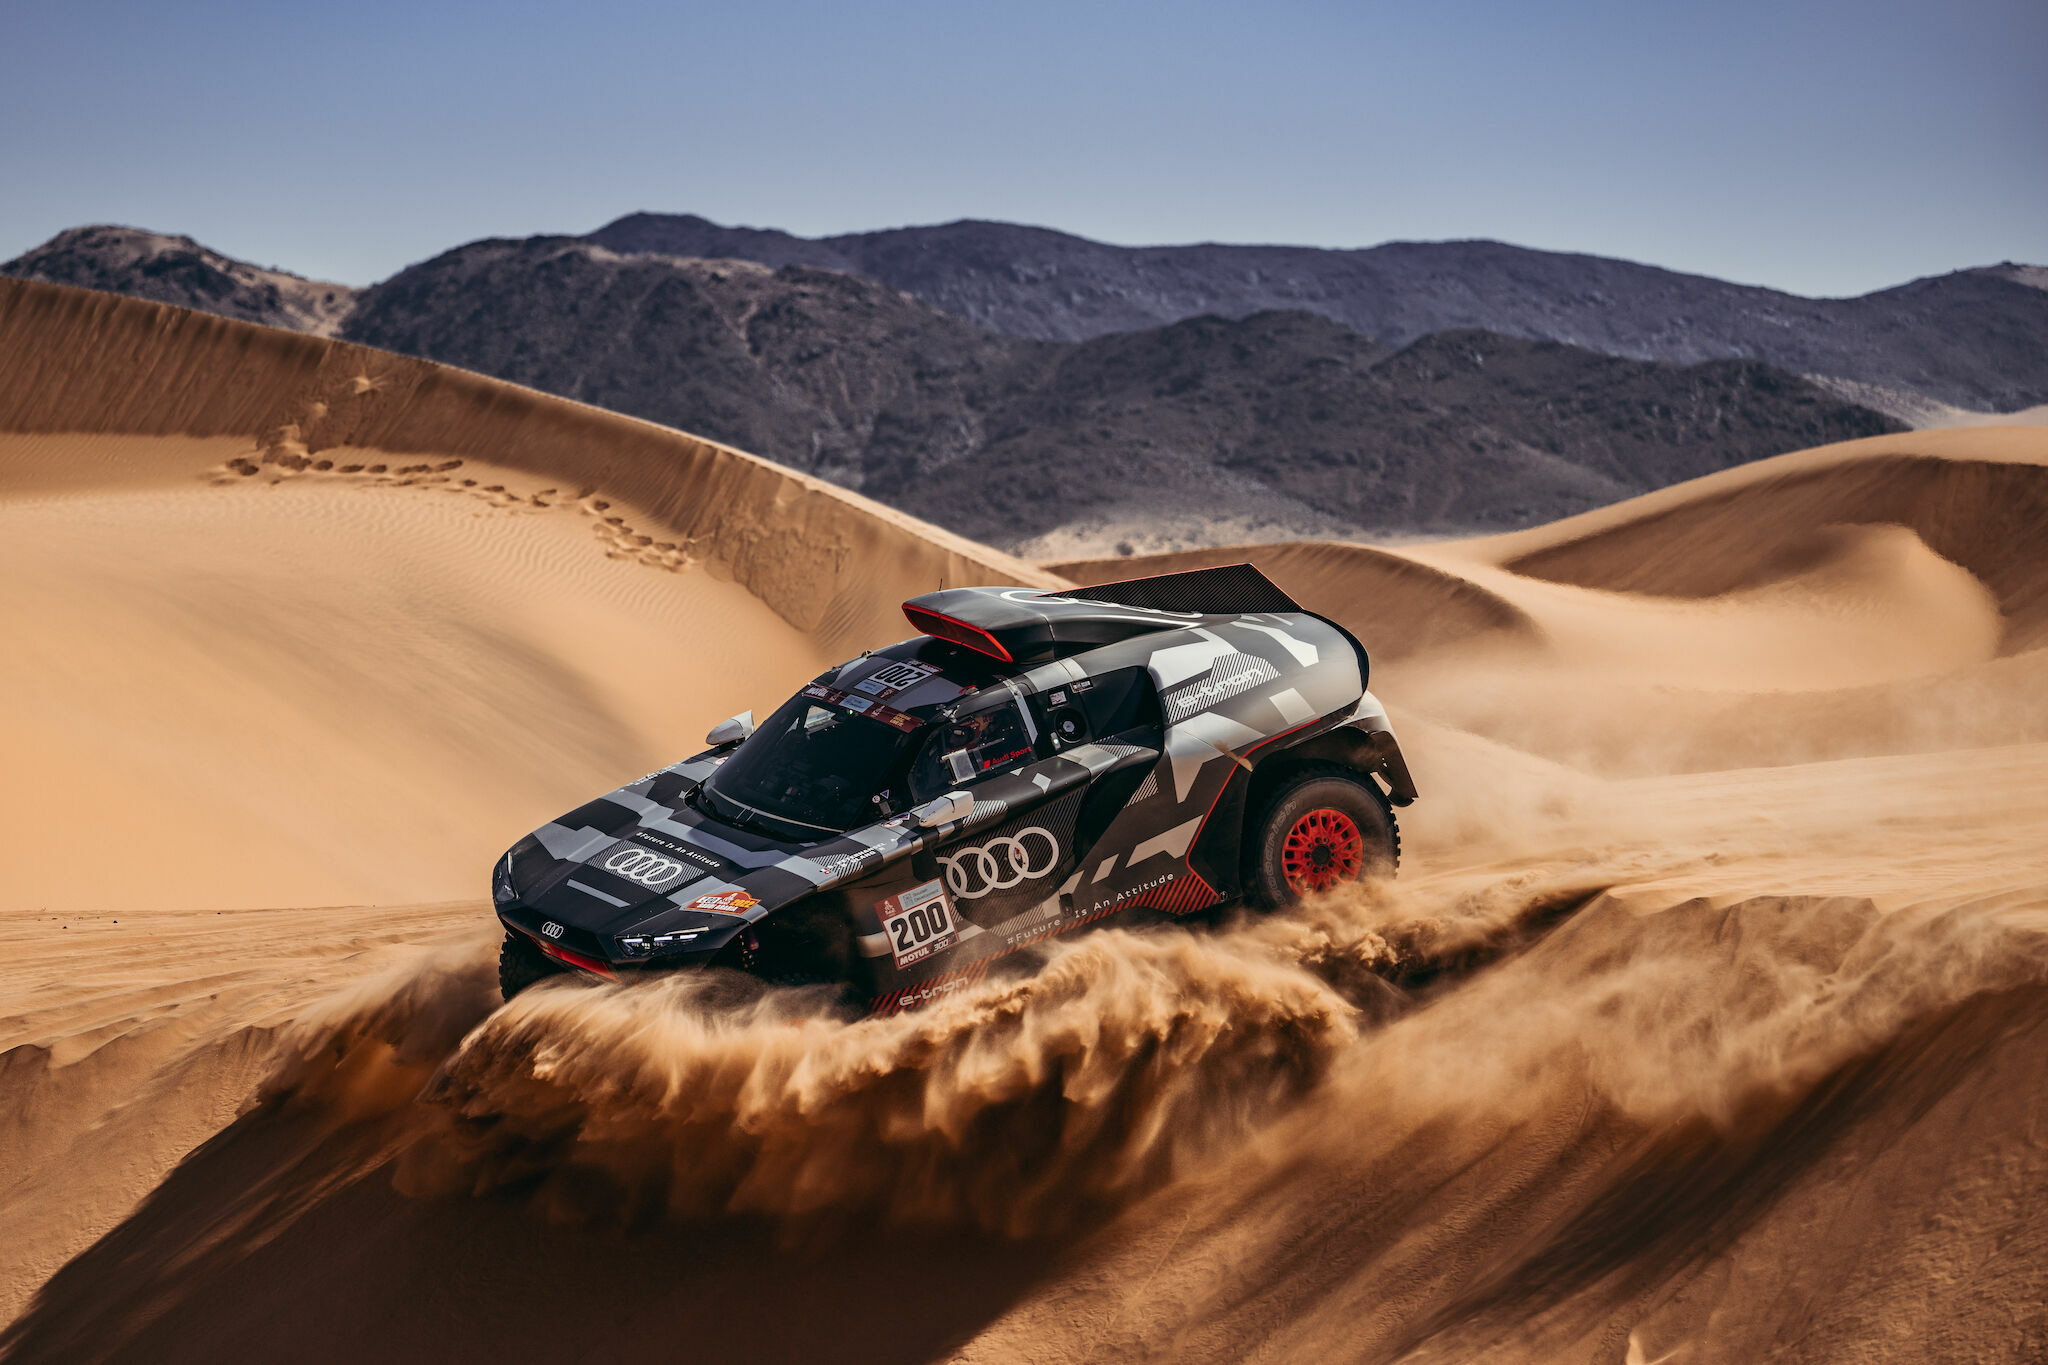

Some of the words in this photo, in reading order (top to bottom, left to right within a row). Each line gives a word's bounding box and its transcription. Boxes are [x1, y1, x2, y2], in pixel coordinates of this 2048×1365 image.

[992, 752, 1010, 765] Audi
[1010, 746, 1032, 759] Sport
[665, 842, 676, 850] Is
[675, 846, 687, 854] An
[686, 850, 721, 868] Attitude
[1006, 918, 1062, 945] #Future
[1075, 908, 1088, 919] Is
[1093, 899, 1111, 911] An
[1116, 872, 1175, 902] Attitude
[890, 901, 948, 952] 200
[900, 947, 930, 965] MOTUL
[899, 976, 969, 1007] e-tron
